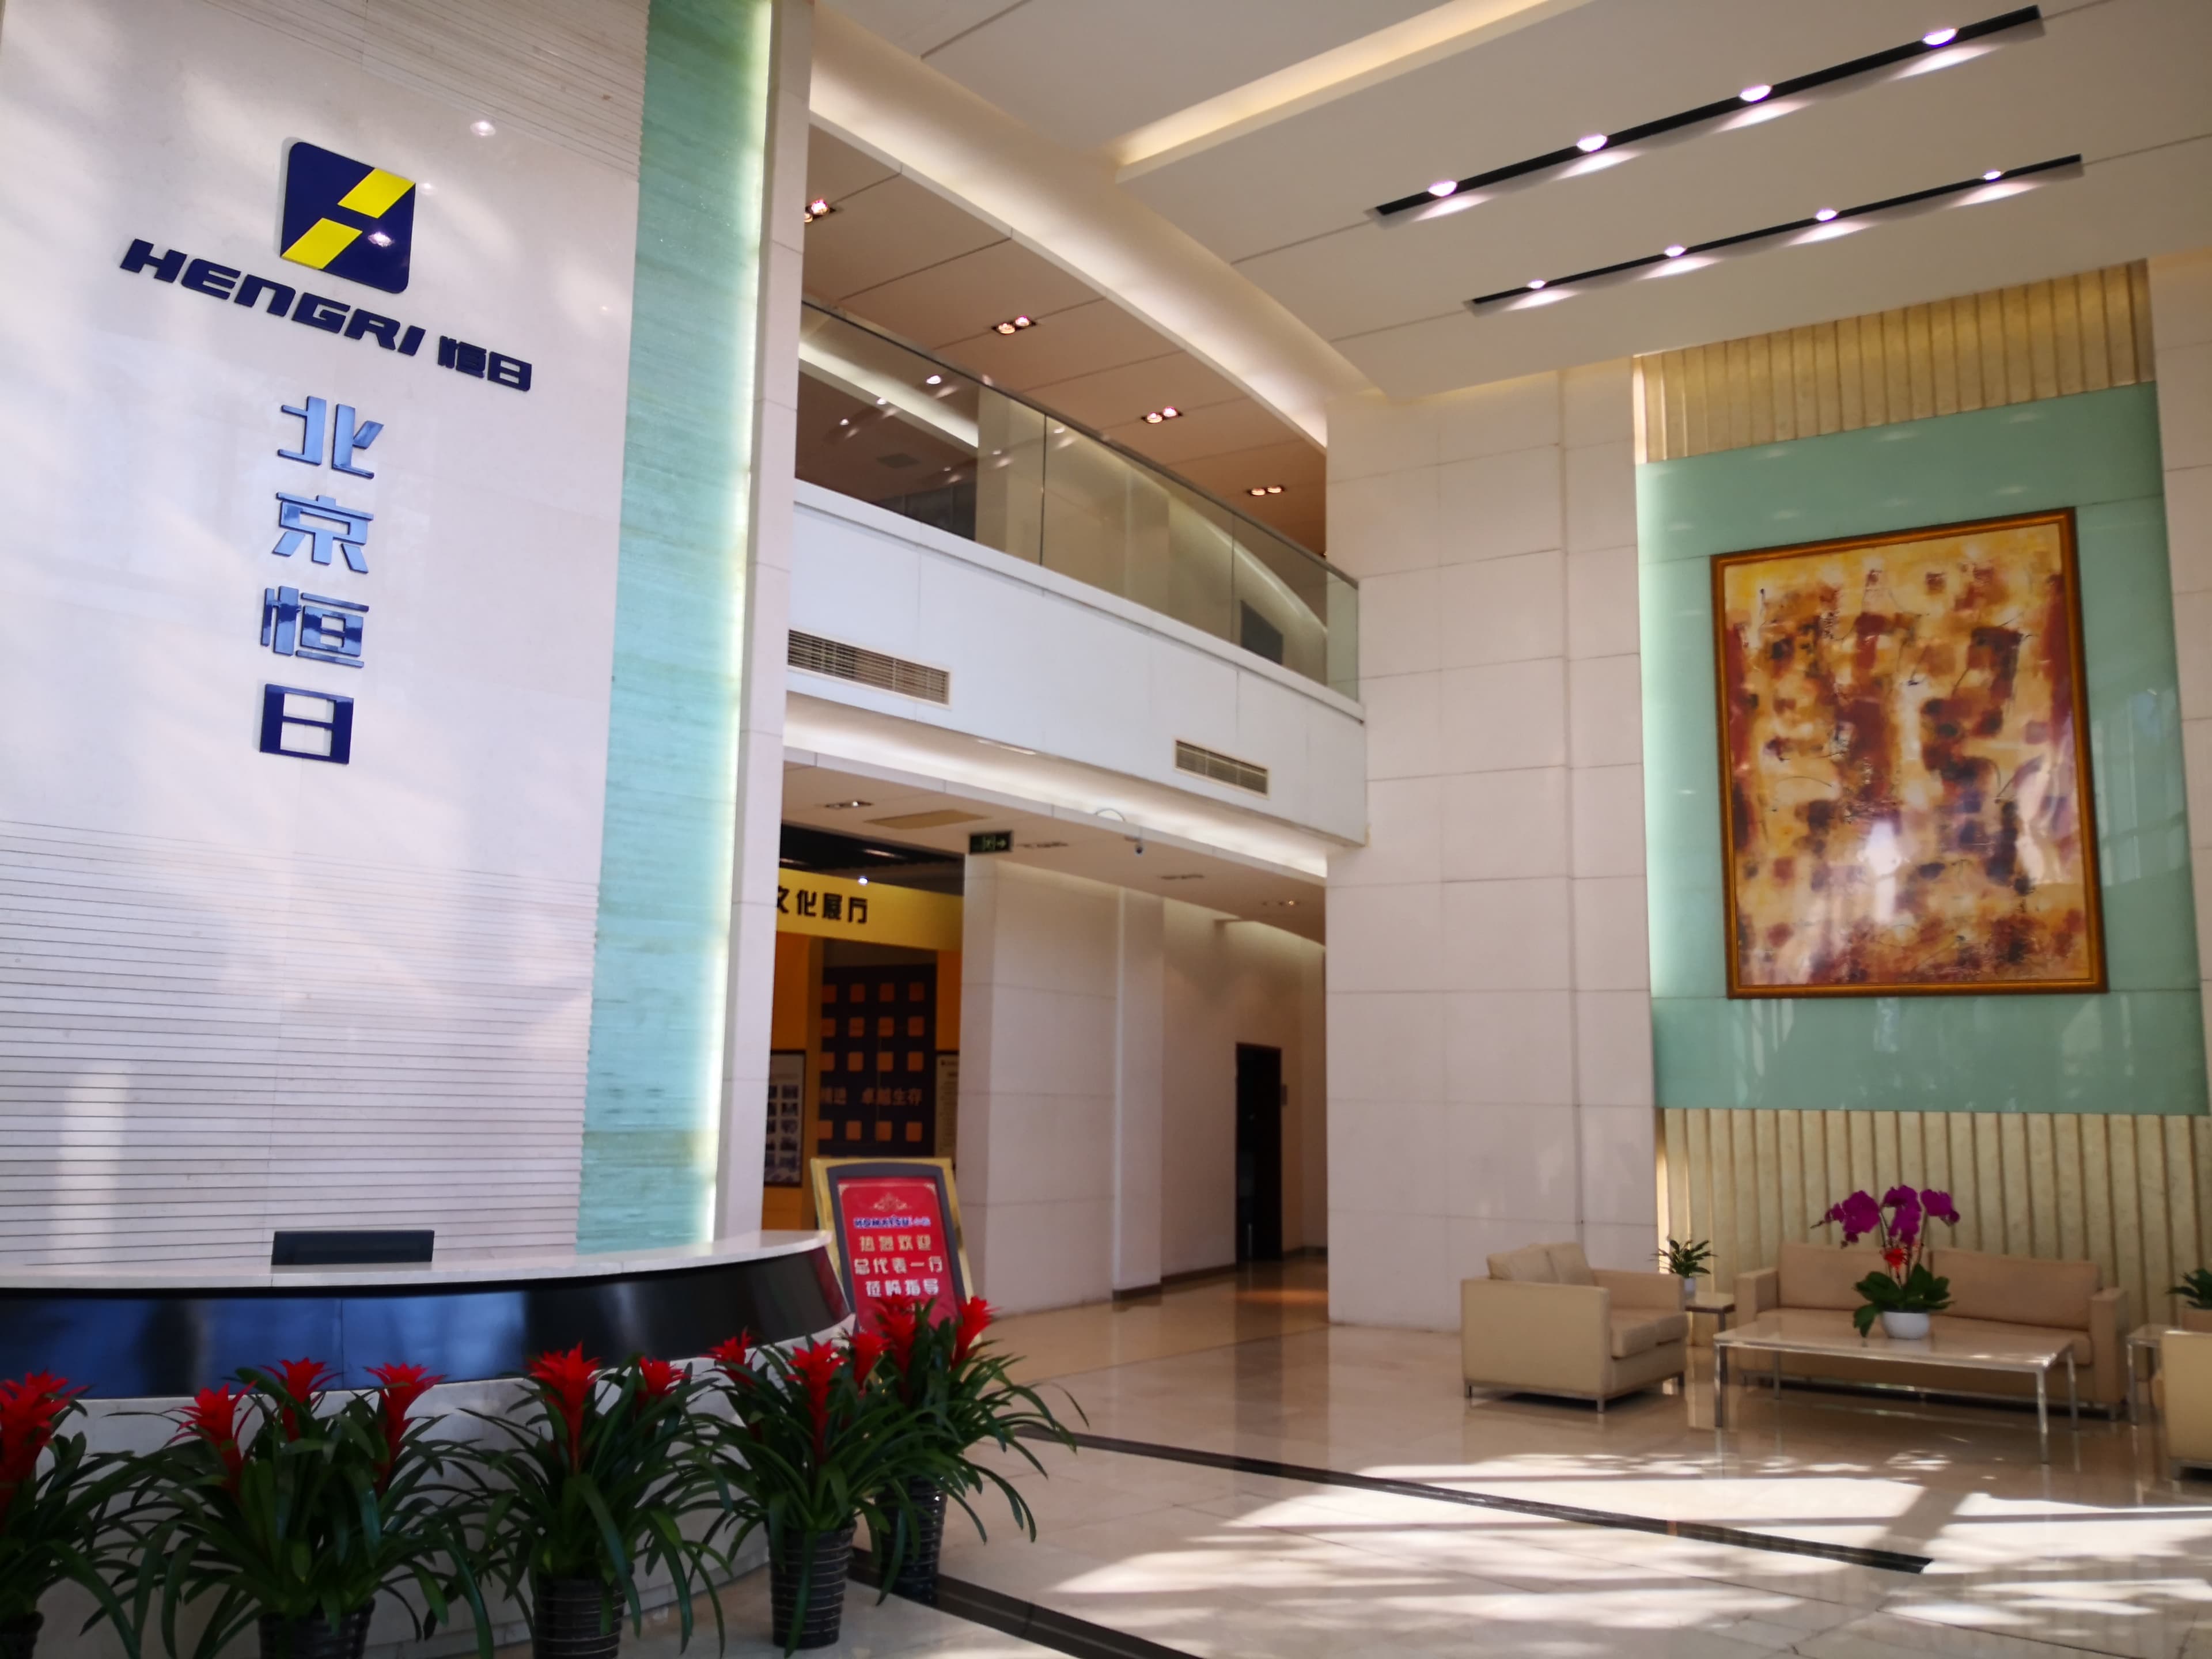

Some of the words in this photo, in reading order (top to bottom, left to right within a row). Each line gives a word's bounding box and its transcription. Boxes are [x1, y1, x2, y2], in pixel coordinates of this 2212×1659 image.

[120, 238, 426, 357] HENGRI
[260, 395, 384, 765] 北京恒日
